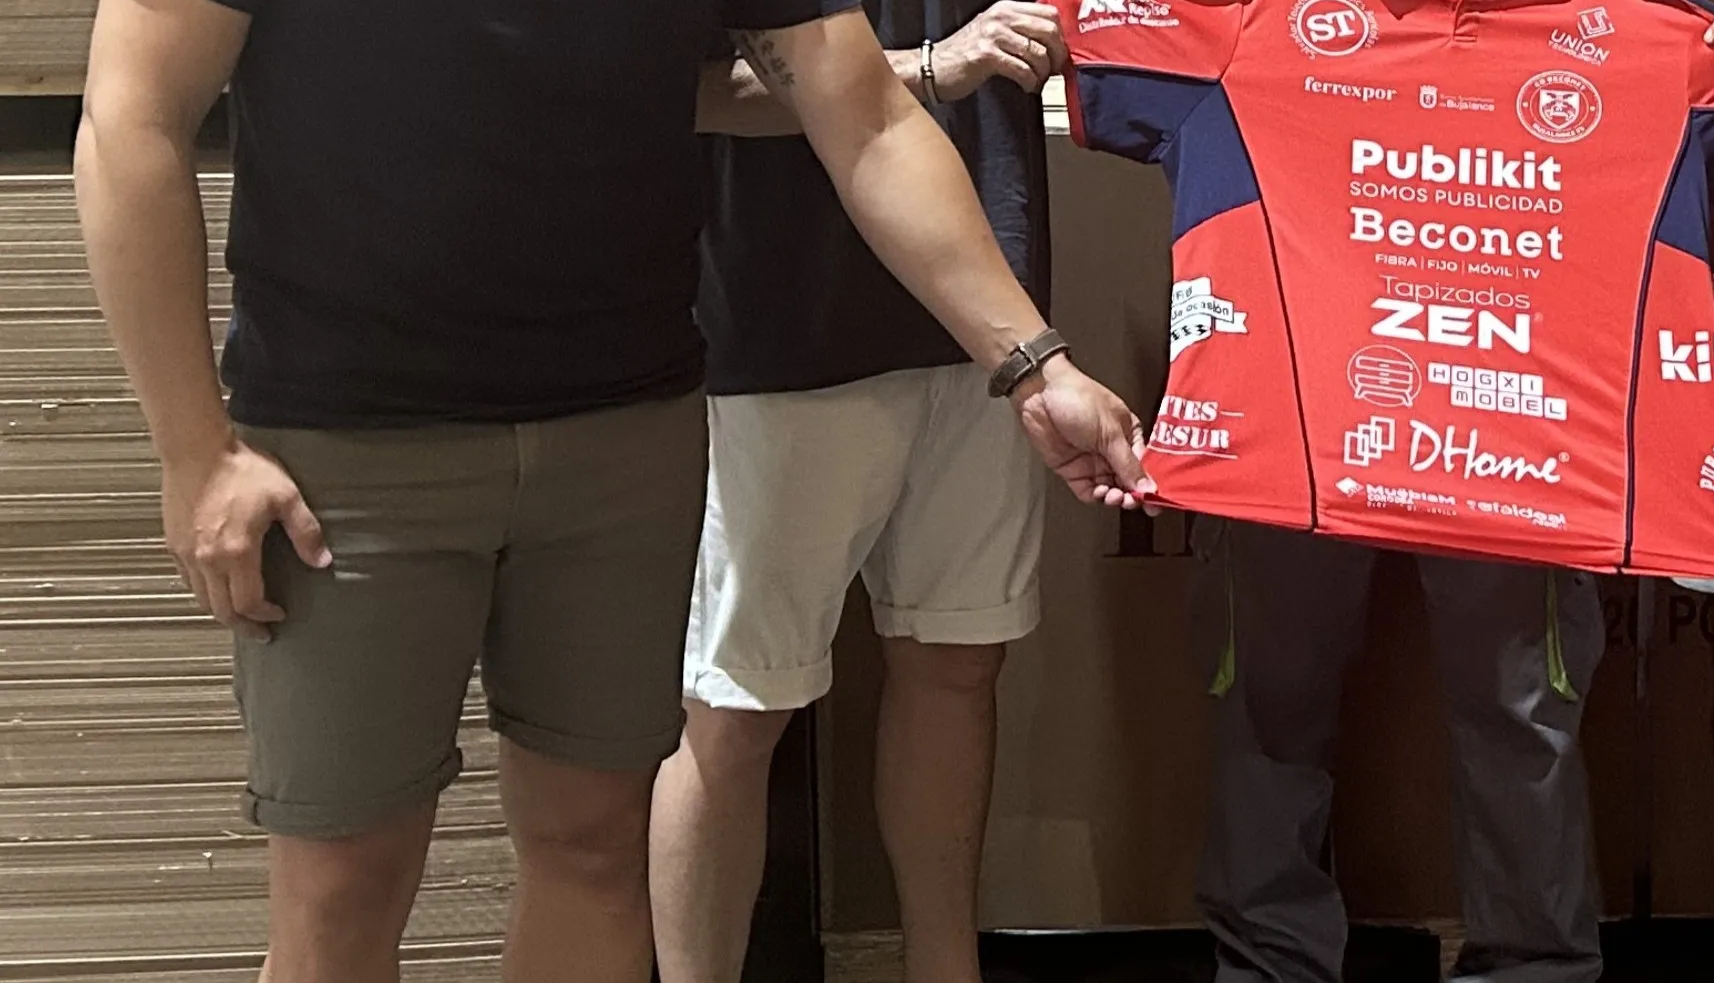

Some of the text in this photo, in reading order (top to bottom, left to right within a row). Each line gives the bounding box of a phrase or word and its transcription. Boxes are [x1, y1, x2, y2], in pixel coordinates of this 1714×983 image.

[1306, 9, 1356, 43] ST
[1304, 75, 1398, 103] ferrexpor
[1351, 138, 1562, 192] Publikit
[1350, 181, 1564, 215] SOMOS PUBLICIDAD
[1350, 206, 1563, 261] Beconet
[1375, 253, 1541, 279] FIBRA FIJO MÓVIL TV
[1380, 274, 1531, 310] Tapizados
[1370, 296, 1531, 354] ZEN
[1430, 367, 1538, 393] HOGXI
[1453, 389, 1565, 417] MOBEL
[1150, 420, 1230, 449] ESUR
